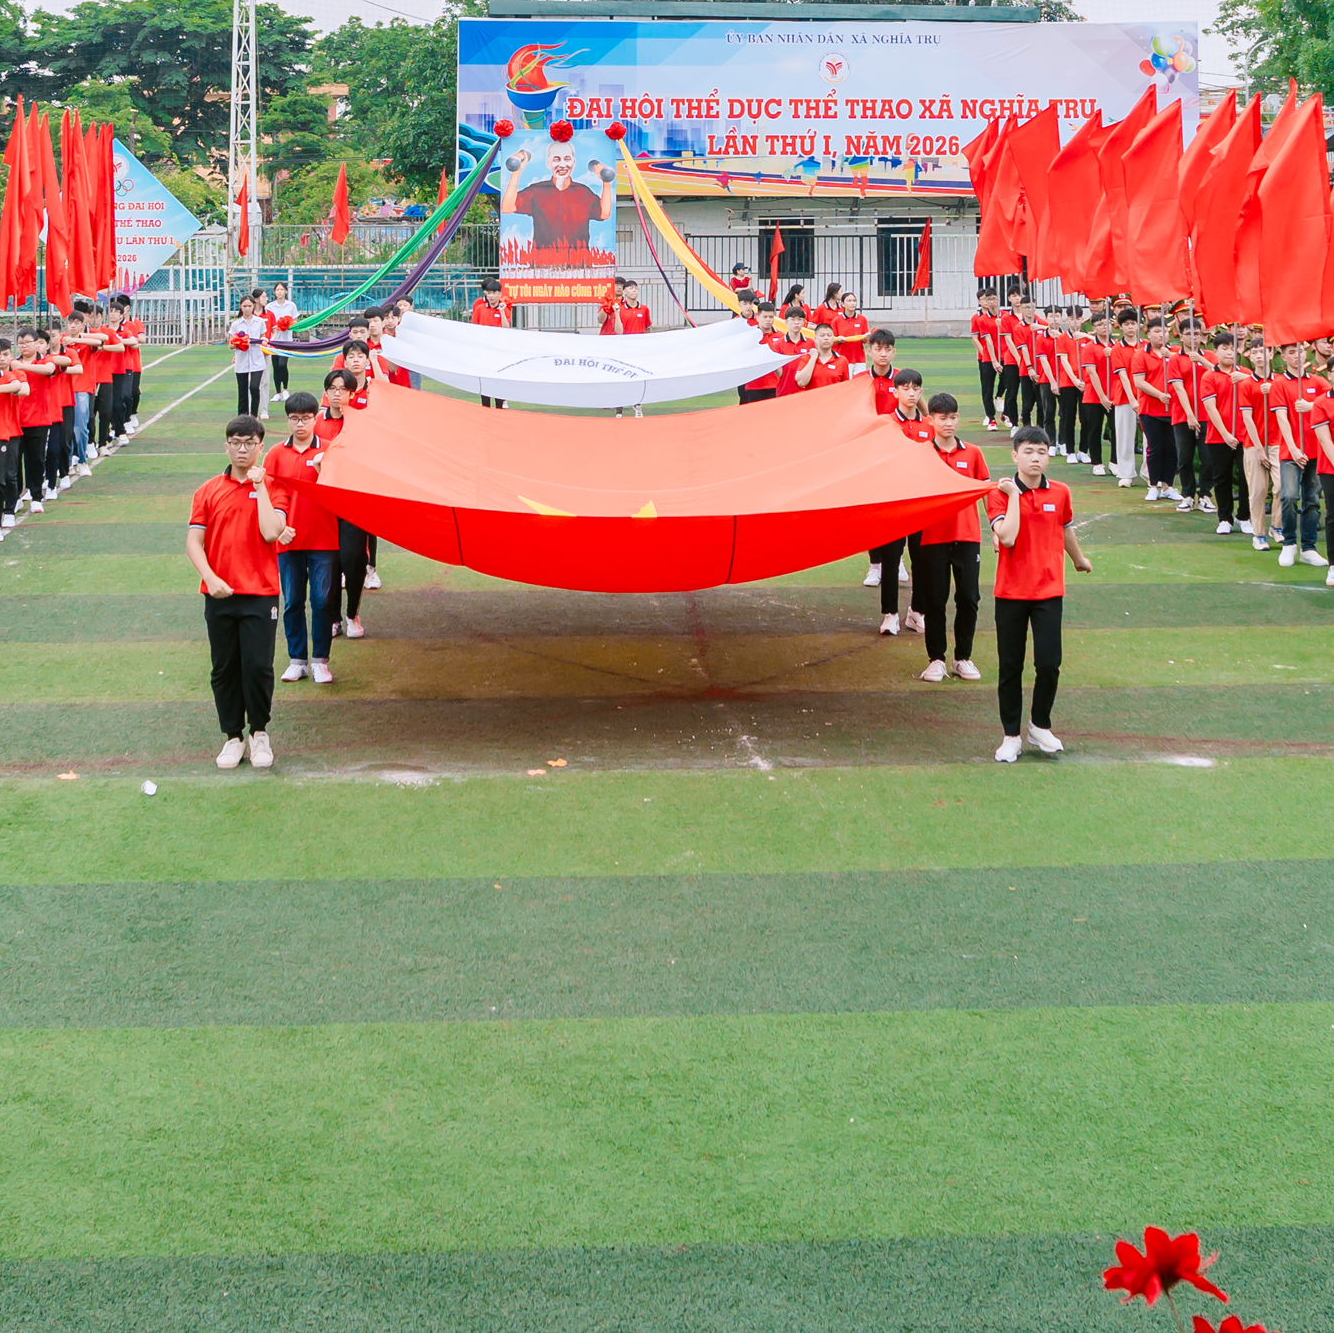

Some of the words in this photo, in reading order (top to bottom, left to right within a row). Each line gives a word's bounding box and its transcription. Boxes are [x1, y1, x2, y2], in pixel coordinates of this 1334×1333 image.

[727, 29, 743, 44] ỦY
[747, 33, 774, 44] BAN
[777, 31, 814, 44] NHÂN
[817, 31, 844, 44] DÂN
[851, 31, 868, 44] XÃ
[872, 31, 912, 44] NGHĨA
[916, 33, 942, 46] TRỤ
[566, 97, 613, 124] ĐẠI
[620, 93, 664, 124] HỘI
[671, 89, 721, 119] THỂ
[727, 97, 781, 124] DỤC
[789, 89, 838, 119] THỂ
[845, 98, 913, 119] THAO
[919, 93, 954, 119] XÃ
[960, 93, 1042, 121] NGHĨA
[707, 127, 759, 156] LẦN
[765, 128, 818, 156] THỨ
[823, 135, 838, 159] I,
[844, 129, 902, 156] NĂM
[908, 134, 961, 157] 2026
[128, 202, 145, 212] ĐẠI
[148, 200, 165, 213] HỘI
[135, 219, 162, 227] THAO
[147, 234, 168, 245] THỨ
[117, 254, 137, 262] 2026
[519, 283, 532, 297] TÔI
[533, 283, 553, 297] NGÀY
[554, 283, 570, 297] NÀO
[571, 283, 592, 297] CŨNG
